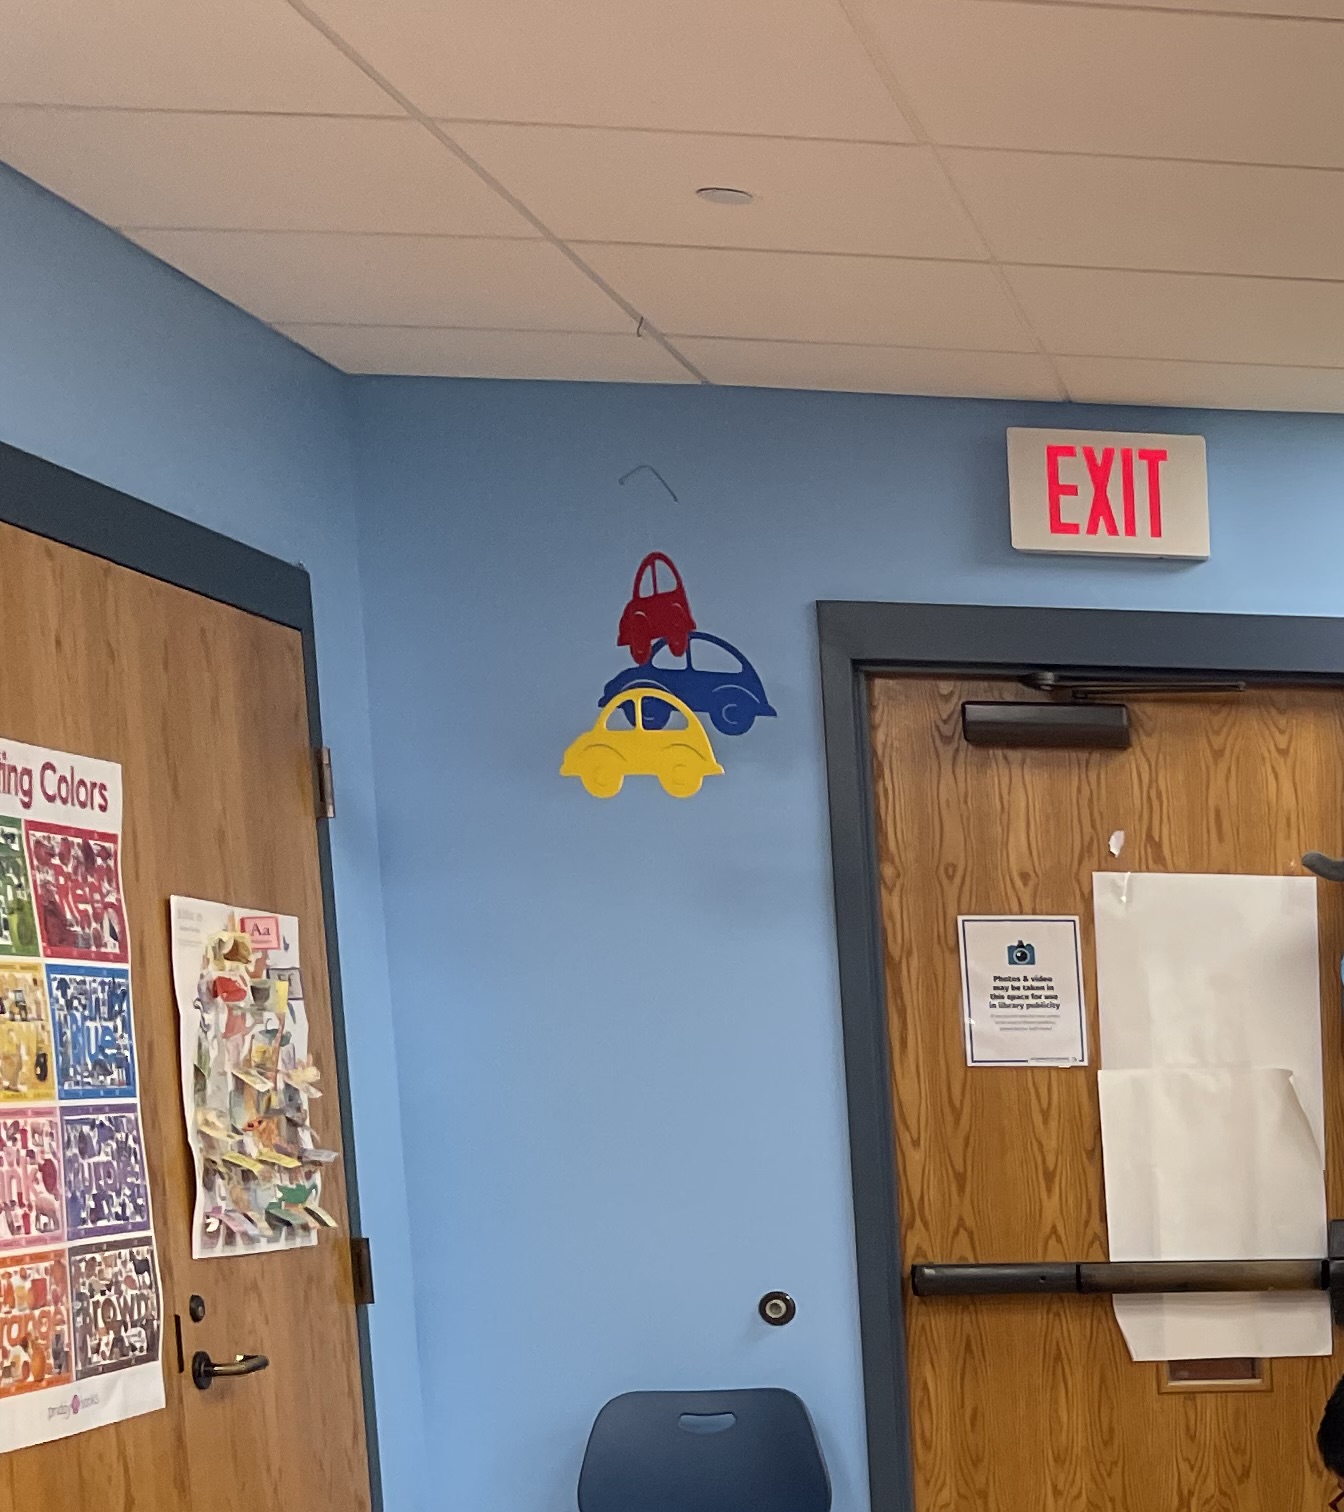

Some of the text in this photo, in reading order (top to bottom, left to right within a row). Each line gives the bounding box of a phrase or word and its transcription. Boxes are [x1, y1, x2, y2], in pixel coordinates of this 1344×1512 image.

[1046, 445, 1168, 538] EXIT
[0, 751, 109, 813] ing Colors
[251, 923, 271, 937] Aa
[1031, 974, 1053, 982] video
[998, 1001, 1024, 1010] library
[1025, 1001, 1060, 1011] publicity
[0, 1304, 66, 1347] range
